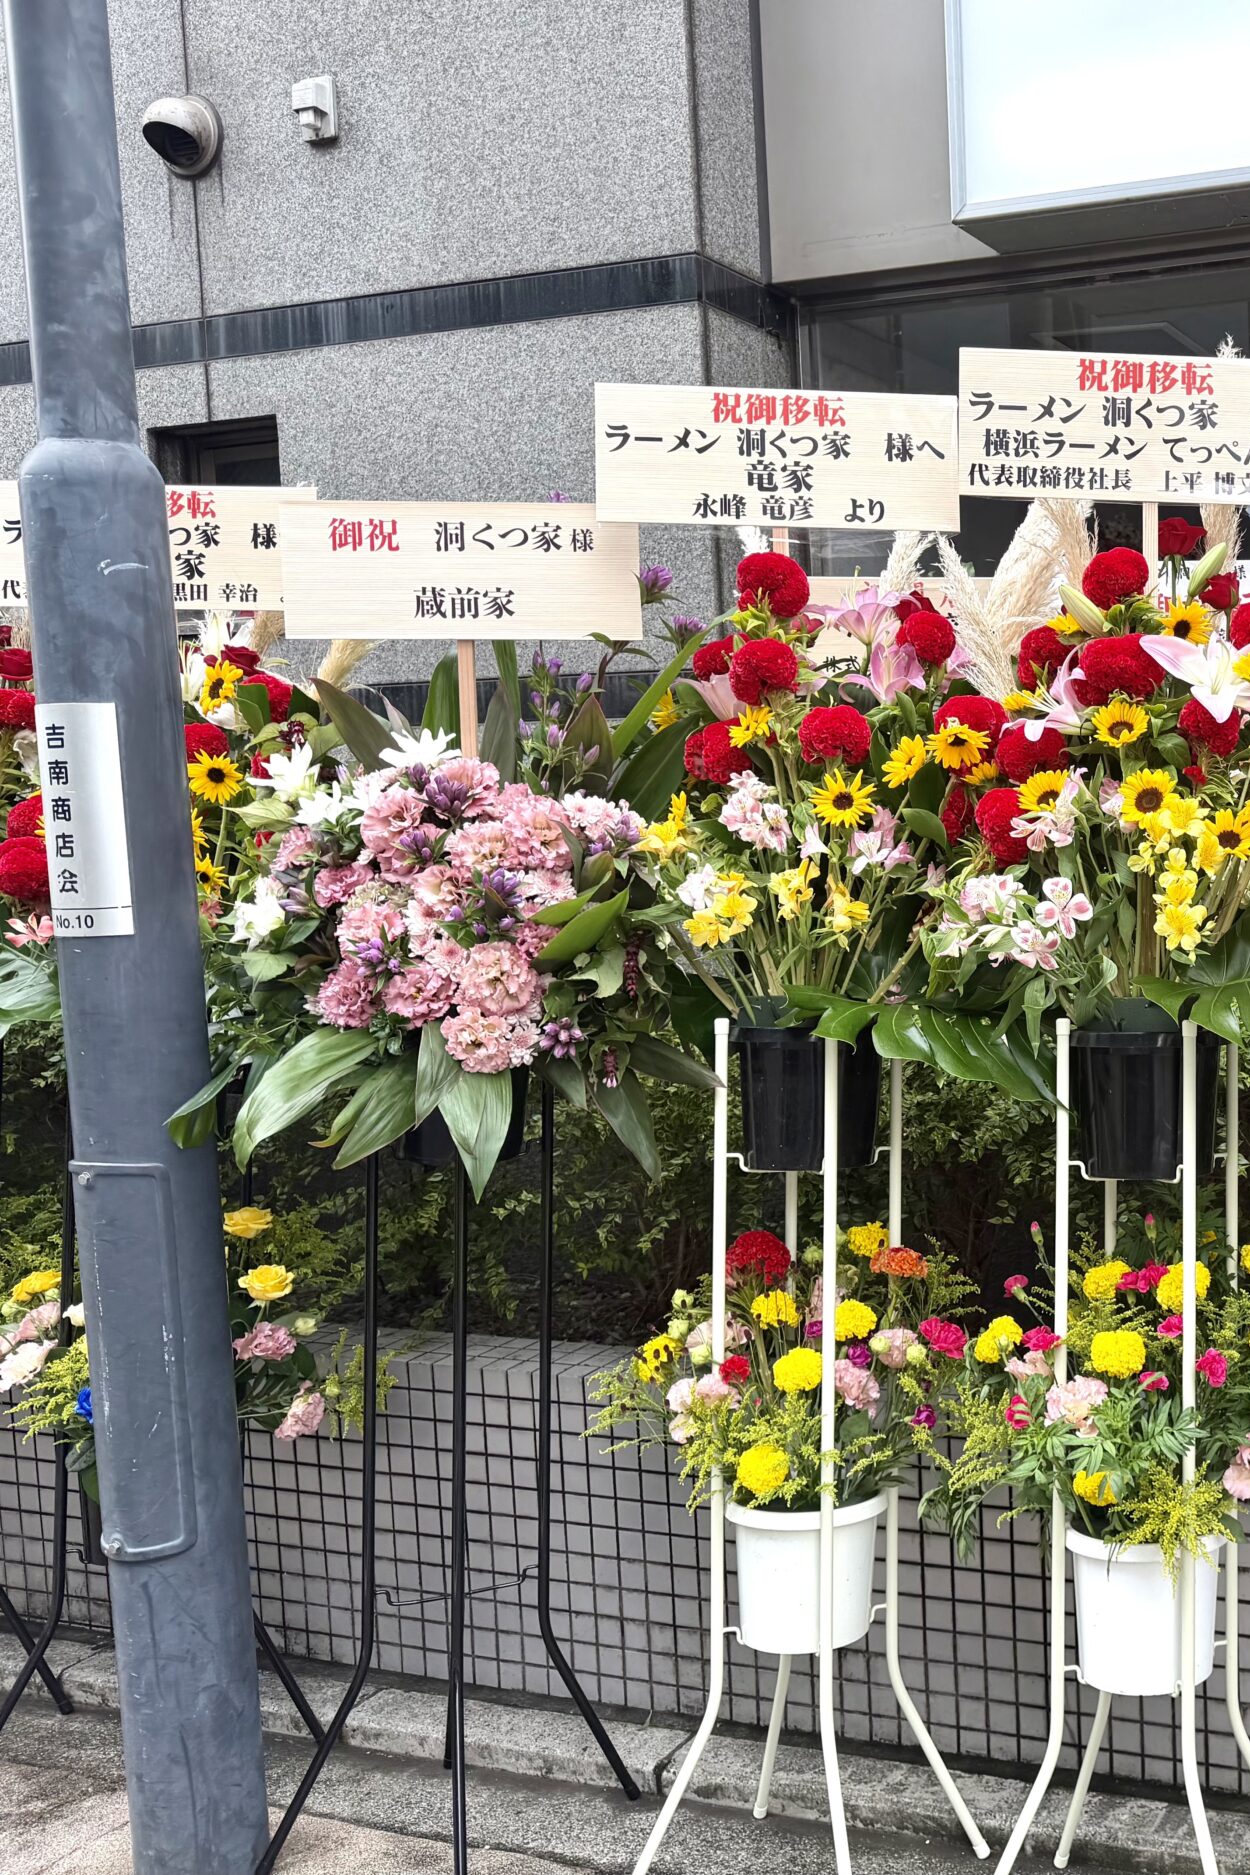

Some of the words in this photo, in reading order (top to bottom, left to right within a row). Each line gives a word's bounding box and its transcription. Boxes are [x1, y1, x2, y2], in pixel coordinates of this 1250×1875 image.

[1076, 358, 1215, 396] 祝御移転
[711, 392, 847, 427] 祝御移転
[969, 391, 1087, 424] ラーメン
[1102, 396, 1219, 430] 洞くつ家
[604, 423, 721, 454] ラーメン
[737, 428, 852, 460] 洞くつ家
[884, 432, 946, 462] 様へ
[983, 428, 1148, 461] 横浜ラーメン
[745, 460, 814, 493] 竜家
[968, 463, 1132, 491] 代表取締役社長
[1158, 470, 1203, 495] 上平
[692, 493, 747, 520] 永峰
[760, 494, 814, 521] 竜彦
[844, 498, 885, 524] より
[328, 518, 400, 552] 御祝
[218, 583, 258, 602] 幸治
[413, 587, 516, 619] 蔵前家
[45, 723, 79, 894] 吉南商店会
[56, 915, 95, 929] No.10
